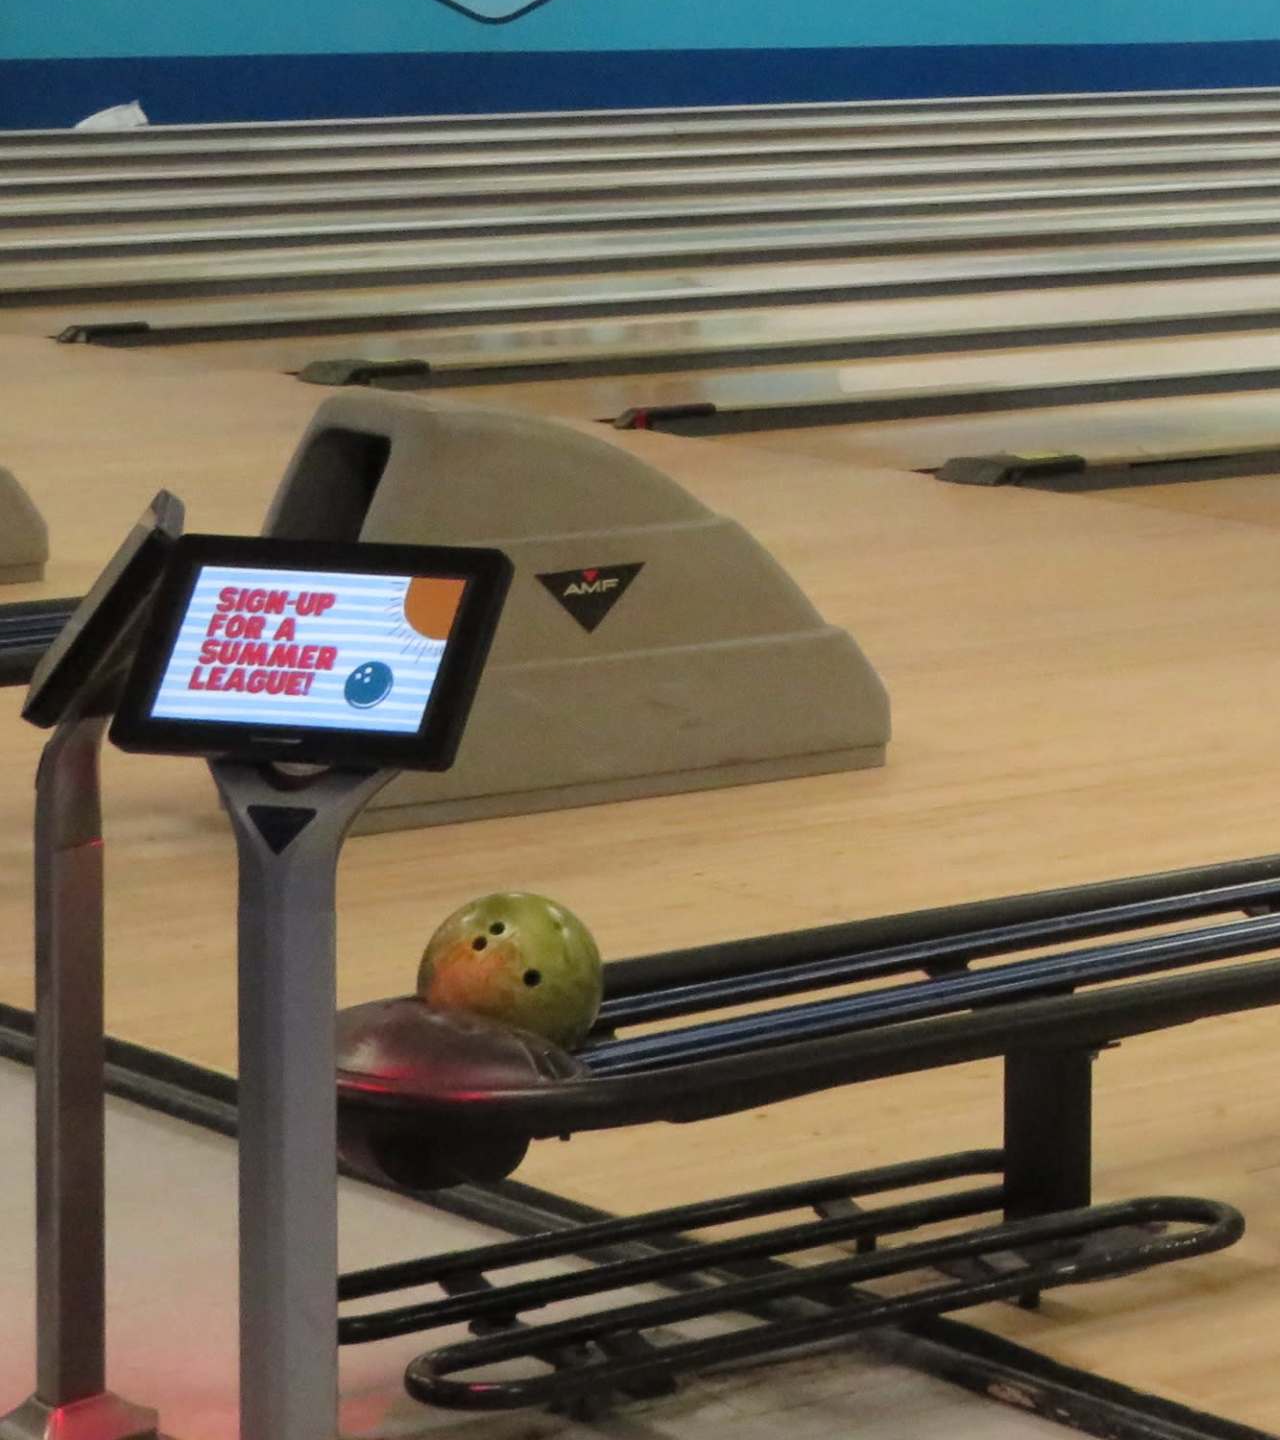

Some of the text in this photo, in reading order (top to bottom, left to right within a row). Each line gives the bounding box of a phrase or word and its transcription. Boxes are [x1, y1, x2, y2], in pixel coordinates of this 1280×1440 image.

[216, 586, 337, 618] SIGN-UP
[562, 577, 621, 597] AMF
[207, 613, 297, 641] FOR A
[198, 640, 338, 672] SUMMER
[188, 666, 314, 697] LEAGUE!
